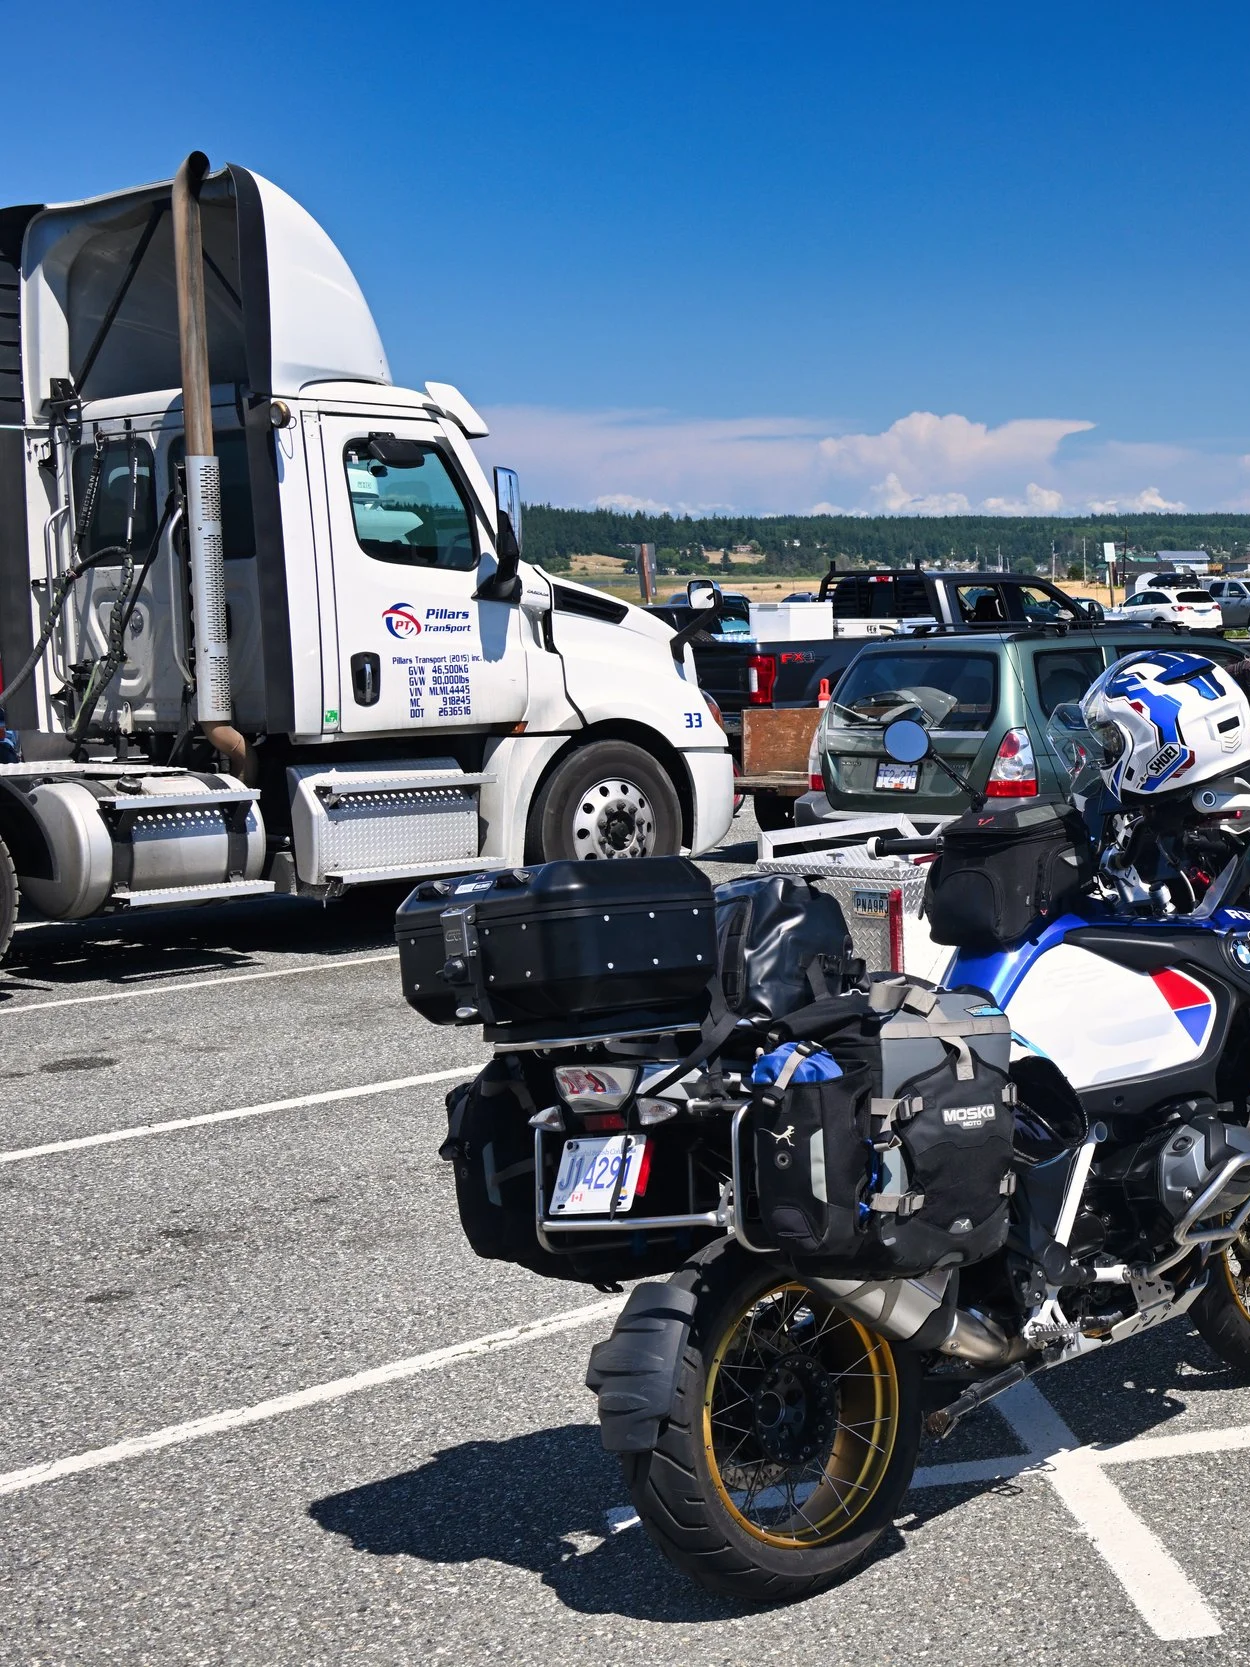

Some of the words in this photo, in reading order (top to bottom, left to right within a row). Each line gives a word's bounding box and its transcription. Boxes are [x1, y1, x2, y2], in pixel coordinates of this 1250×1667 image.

[81, 475, 96, 517] TECTRAN
[425, 608, 470, 620] Pillars
[395, 620, 412, 630] PT
[392, 657, 413, 665] Pillars
[415, 656, 447, 665] Transport
[471, 653, 483, 662] inc.
[408, 666, 426, 676] GVW
[432, 664, 469, 675] 46,500KG
[408, 676, 426, 687] GVW
[432, 675, 470, 686] 90,000lbs
[409, 687, 423, 697] VIN
[429, 685, 471, 696] MLML4445
[410, 698, 421, 708] MC
[442, 695, 471, 706] 918245
[410, 708, 425, 719] DOT
[438, 705, 472, 717] 2636516
[683, 712, 703, 729] 33
[1149, 745, 1179, 775] SHOEI
[943, 1105, 996, 1123] MOSKO
[962, 1119, 982, 1128] MOTO
[558, 1154, 633, 1191] J14291
